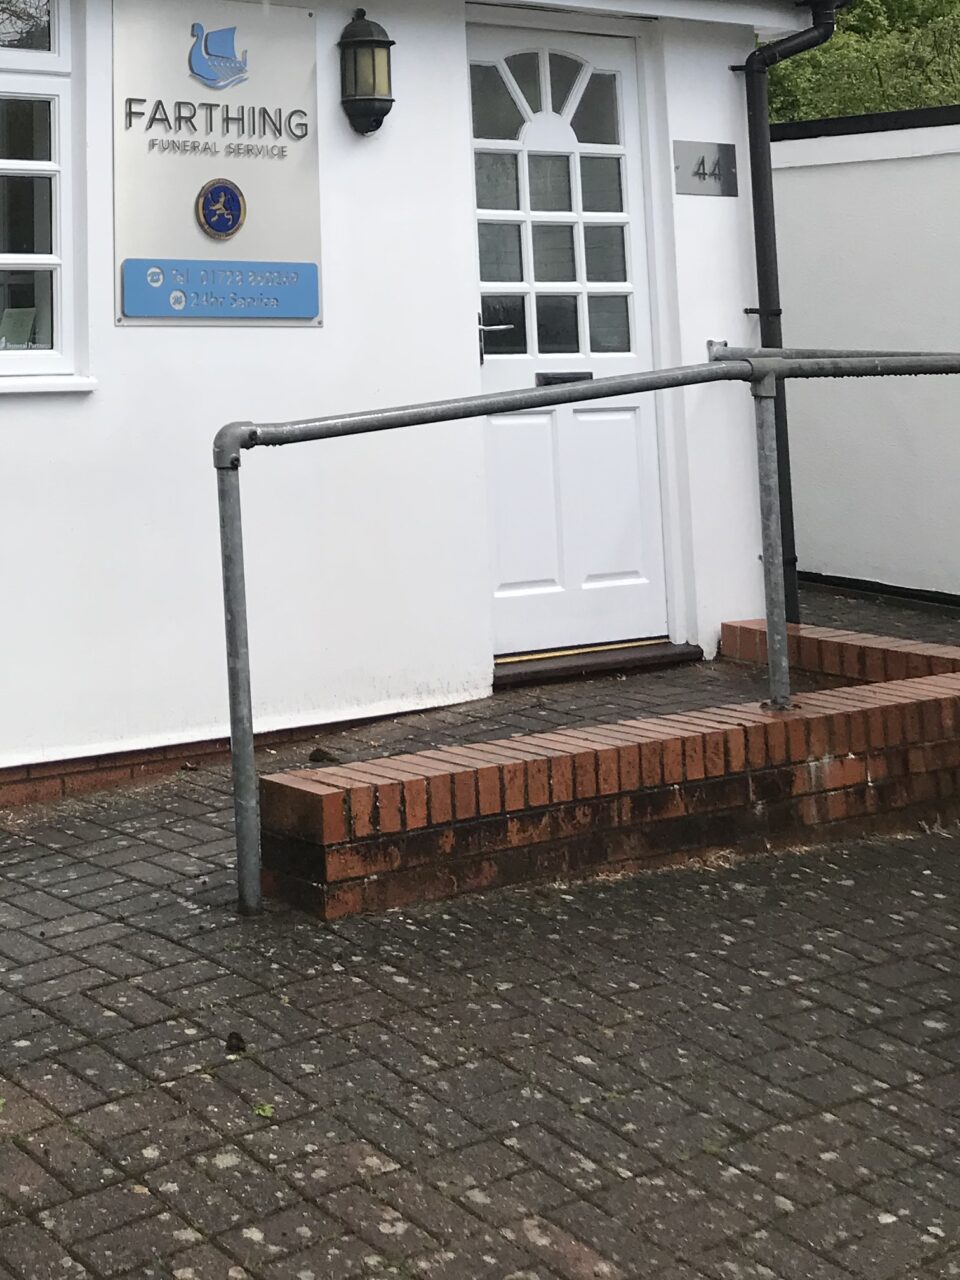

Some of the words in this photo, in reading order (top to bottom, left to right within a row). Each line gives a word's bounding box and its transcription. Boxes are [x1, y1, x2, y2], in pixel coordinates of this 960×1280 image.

[125, 97, 309, 140] FARTHING
[149, 138, 220, 154] FUNERAL
[225, 142, 289, 158] SERVICE
[694, 155, 721, 181] 44
[229, 291, 280, 309] Service
